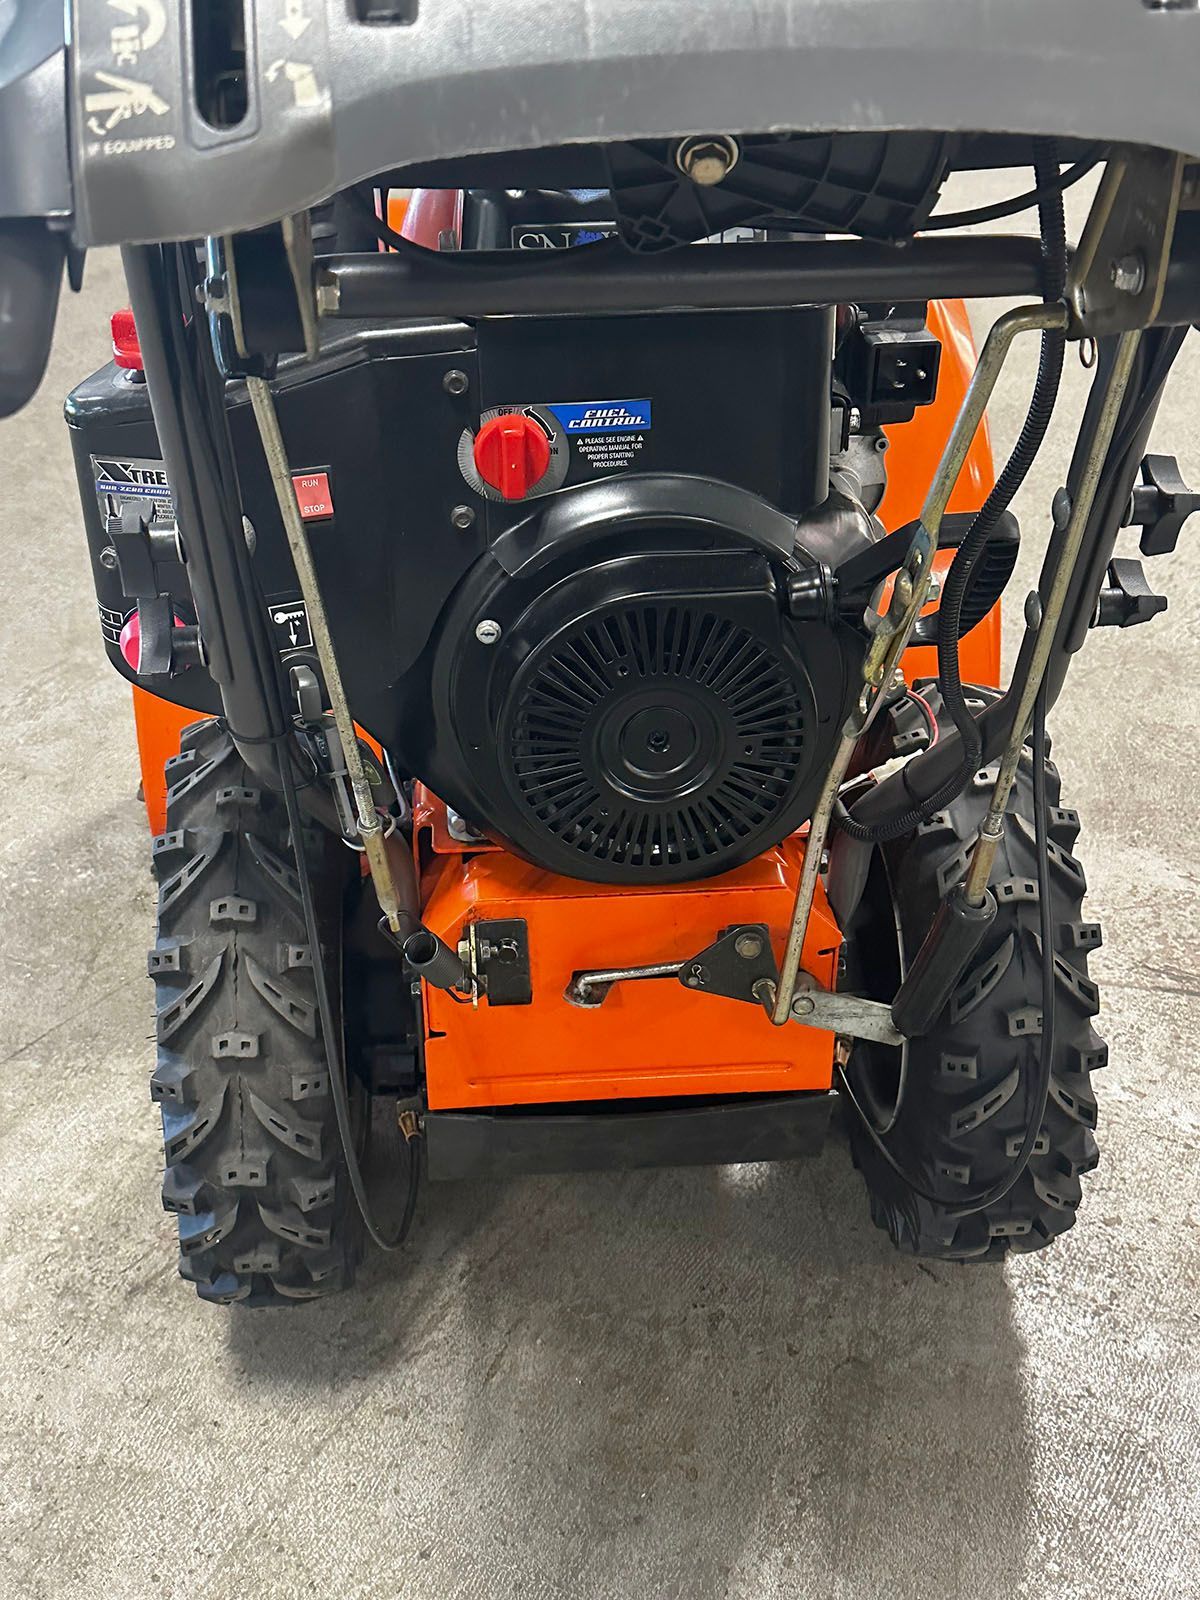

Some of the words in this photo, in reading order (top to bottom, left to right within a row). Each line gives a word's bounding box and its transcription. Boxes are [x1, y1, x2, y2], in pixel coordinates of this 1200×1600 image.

[103, 135, 175, 155] EQUIPPED
[498, 408, 513, 416] OFF
[584, 408, 631, 419] FUEL
[568, 416, 646, 428] CONTROL
[578, 445, 608, 453] OPERATING
[608, 443, 631, 451] MANUAL
[609, 451, 635, 459] STARTING
[94, 460, 169, 487] XTRE
[301, 479, 319, 488] RUN
[304, 504, 325, 513] STOP
